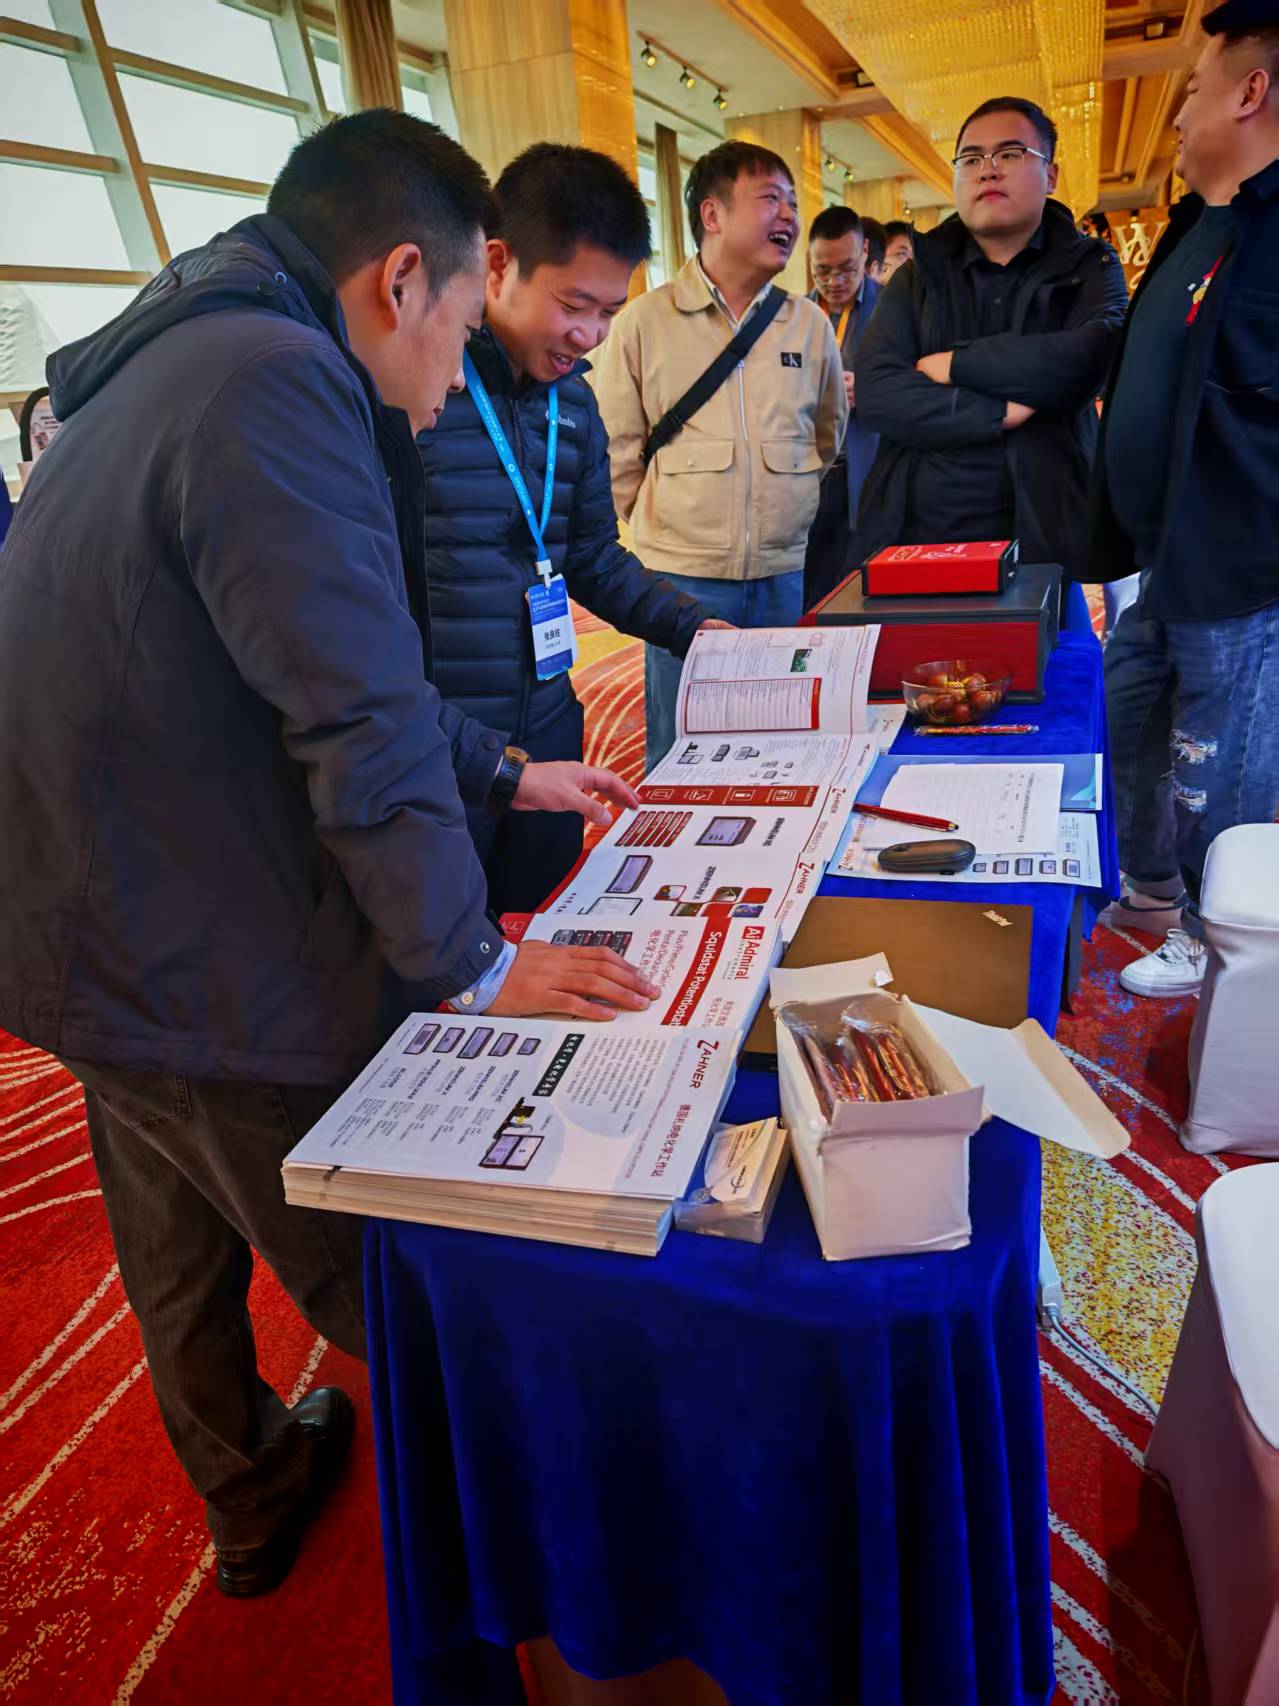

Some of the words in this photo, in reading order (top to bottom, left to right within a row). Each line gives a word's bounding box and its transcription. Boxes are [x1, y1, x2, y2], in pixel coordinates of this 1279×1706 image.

[797, 861, 815, 895] ZAHNER
[696, 931, 722, 975] Squidstat
[734, 940, 761, 980] Admiral
[688, 1039, 720, 1089] ZAHNER
